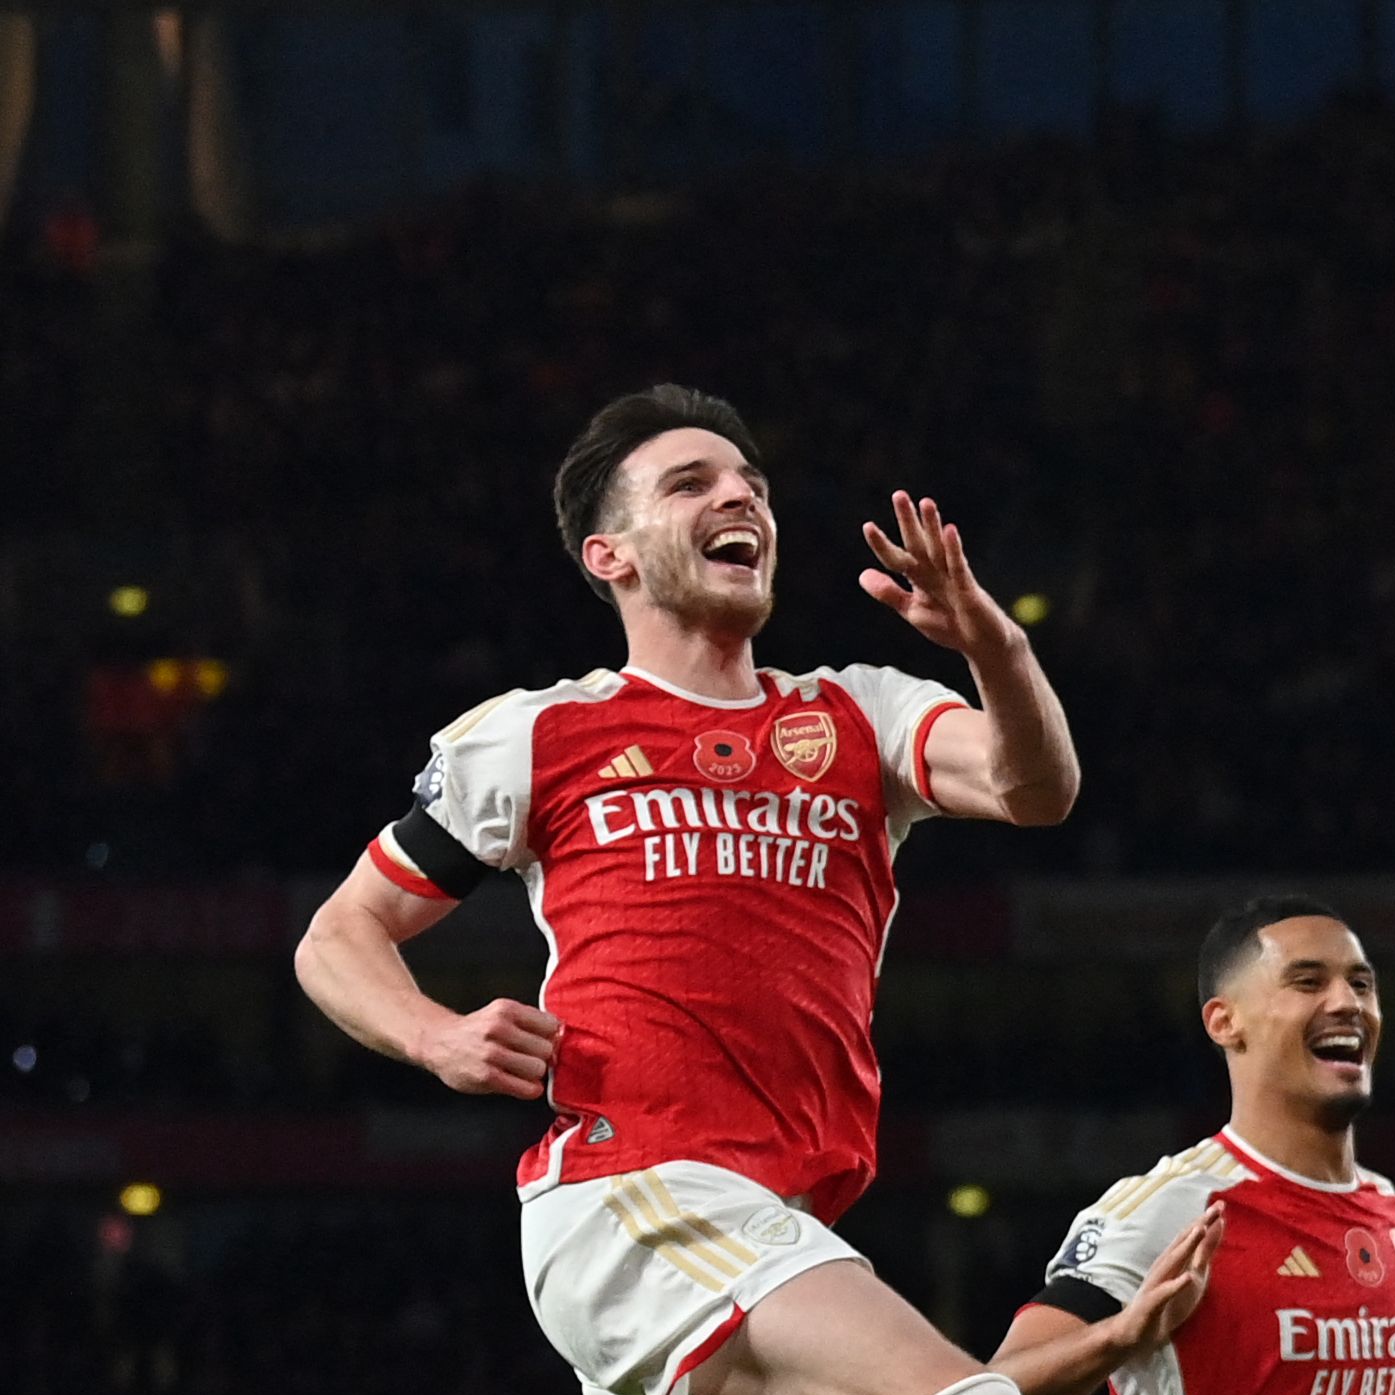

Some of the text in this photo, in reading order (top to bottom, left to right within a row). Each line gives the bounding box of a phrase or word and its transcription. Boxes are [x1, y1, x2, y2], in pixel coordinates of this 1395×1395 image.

[779, 723, 825, 738] Arsenal
[584, 785, 860, 846] Emirates
[644, 832, 829, 889] FLY BETTER
